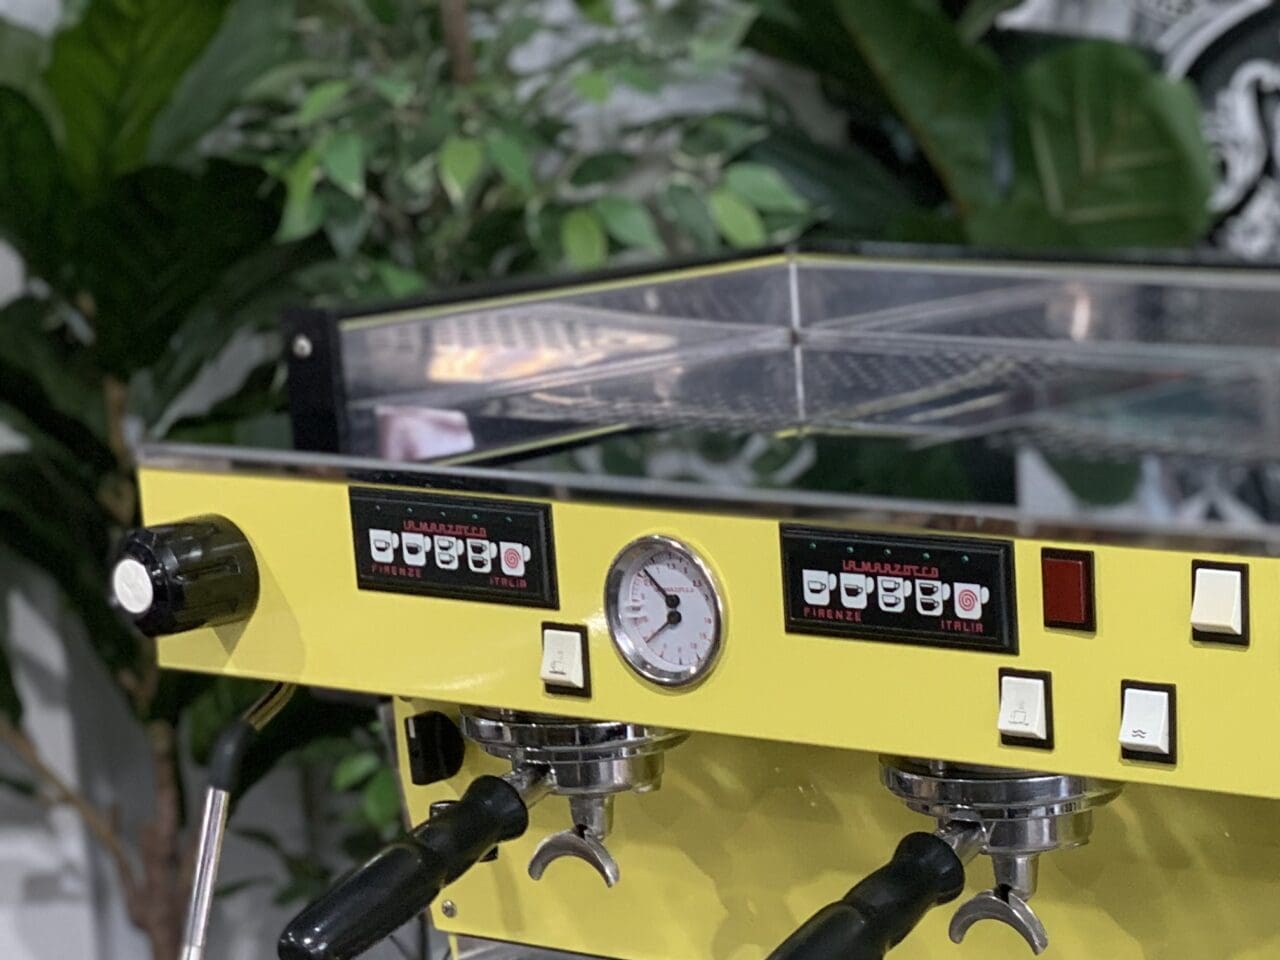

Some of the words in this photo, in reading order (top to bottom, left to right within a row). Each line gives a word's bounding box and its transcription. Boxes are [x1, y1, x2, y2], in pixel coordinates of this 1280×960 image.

[371, 564, 423, 579] FIRENZE
[489, 575, 528, 589] ITALIA
[803, 606, 862, 623] FIRENZE
[940, 619, 984, 633] ITALIA
